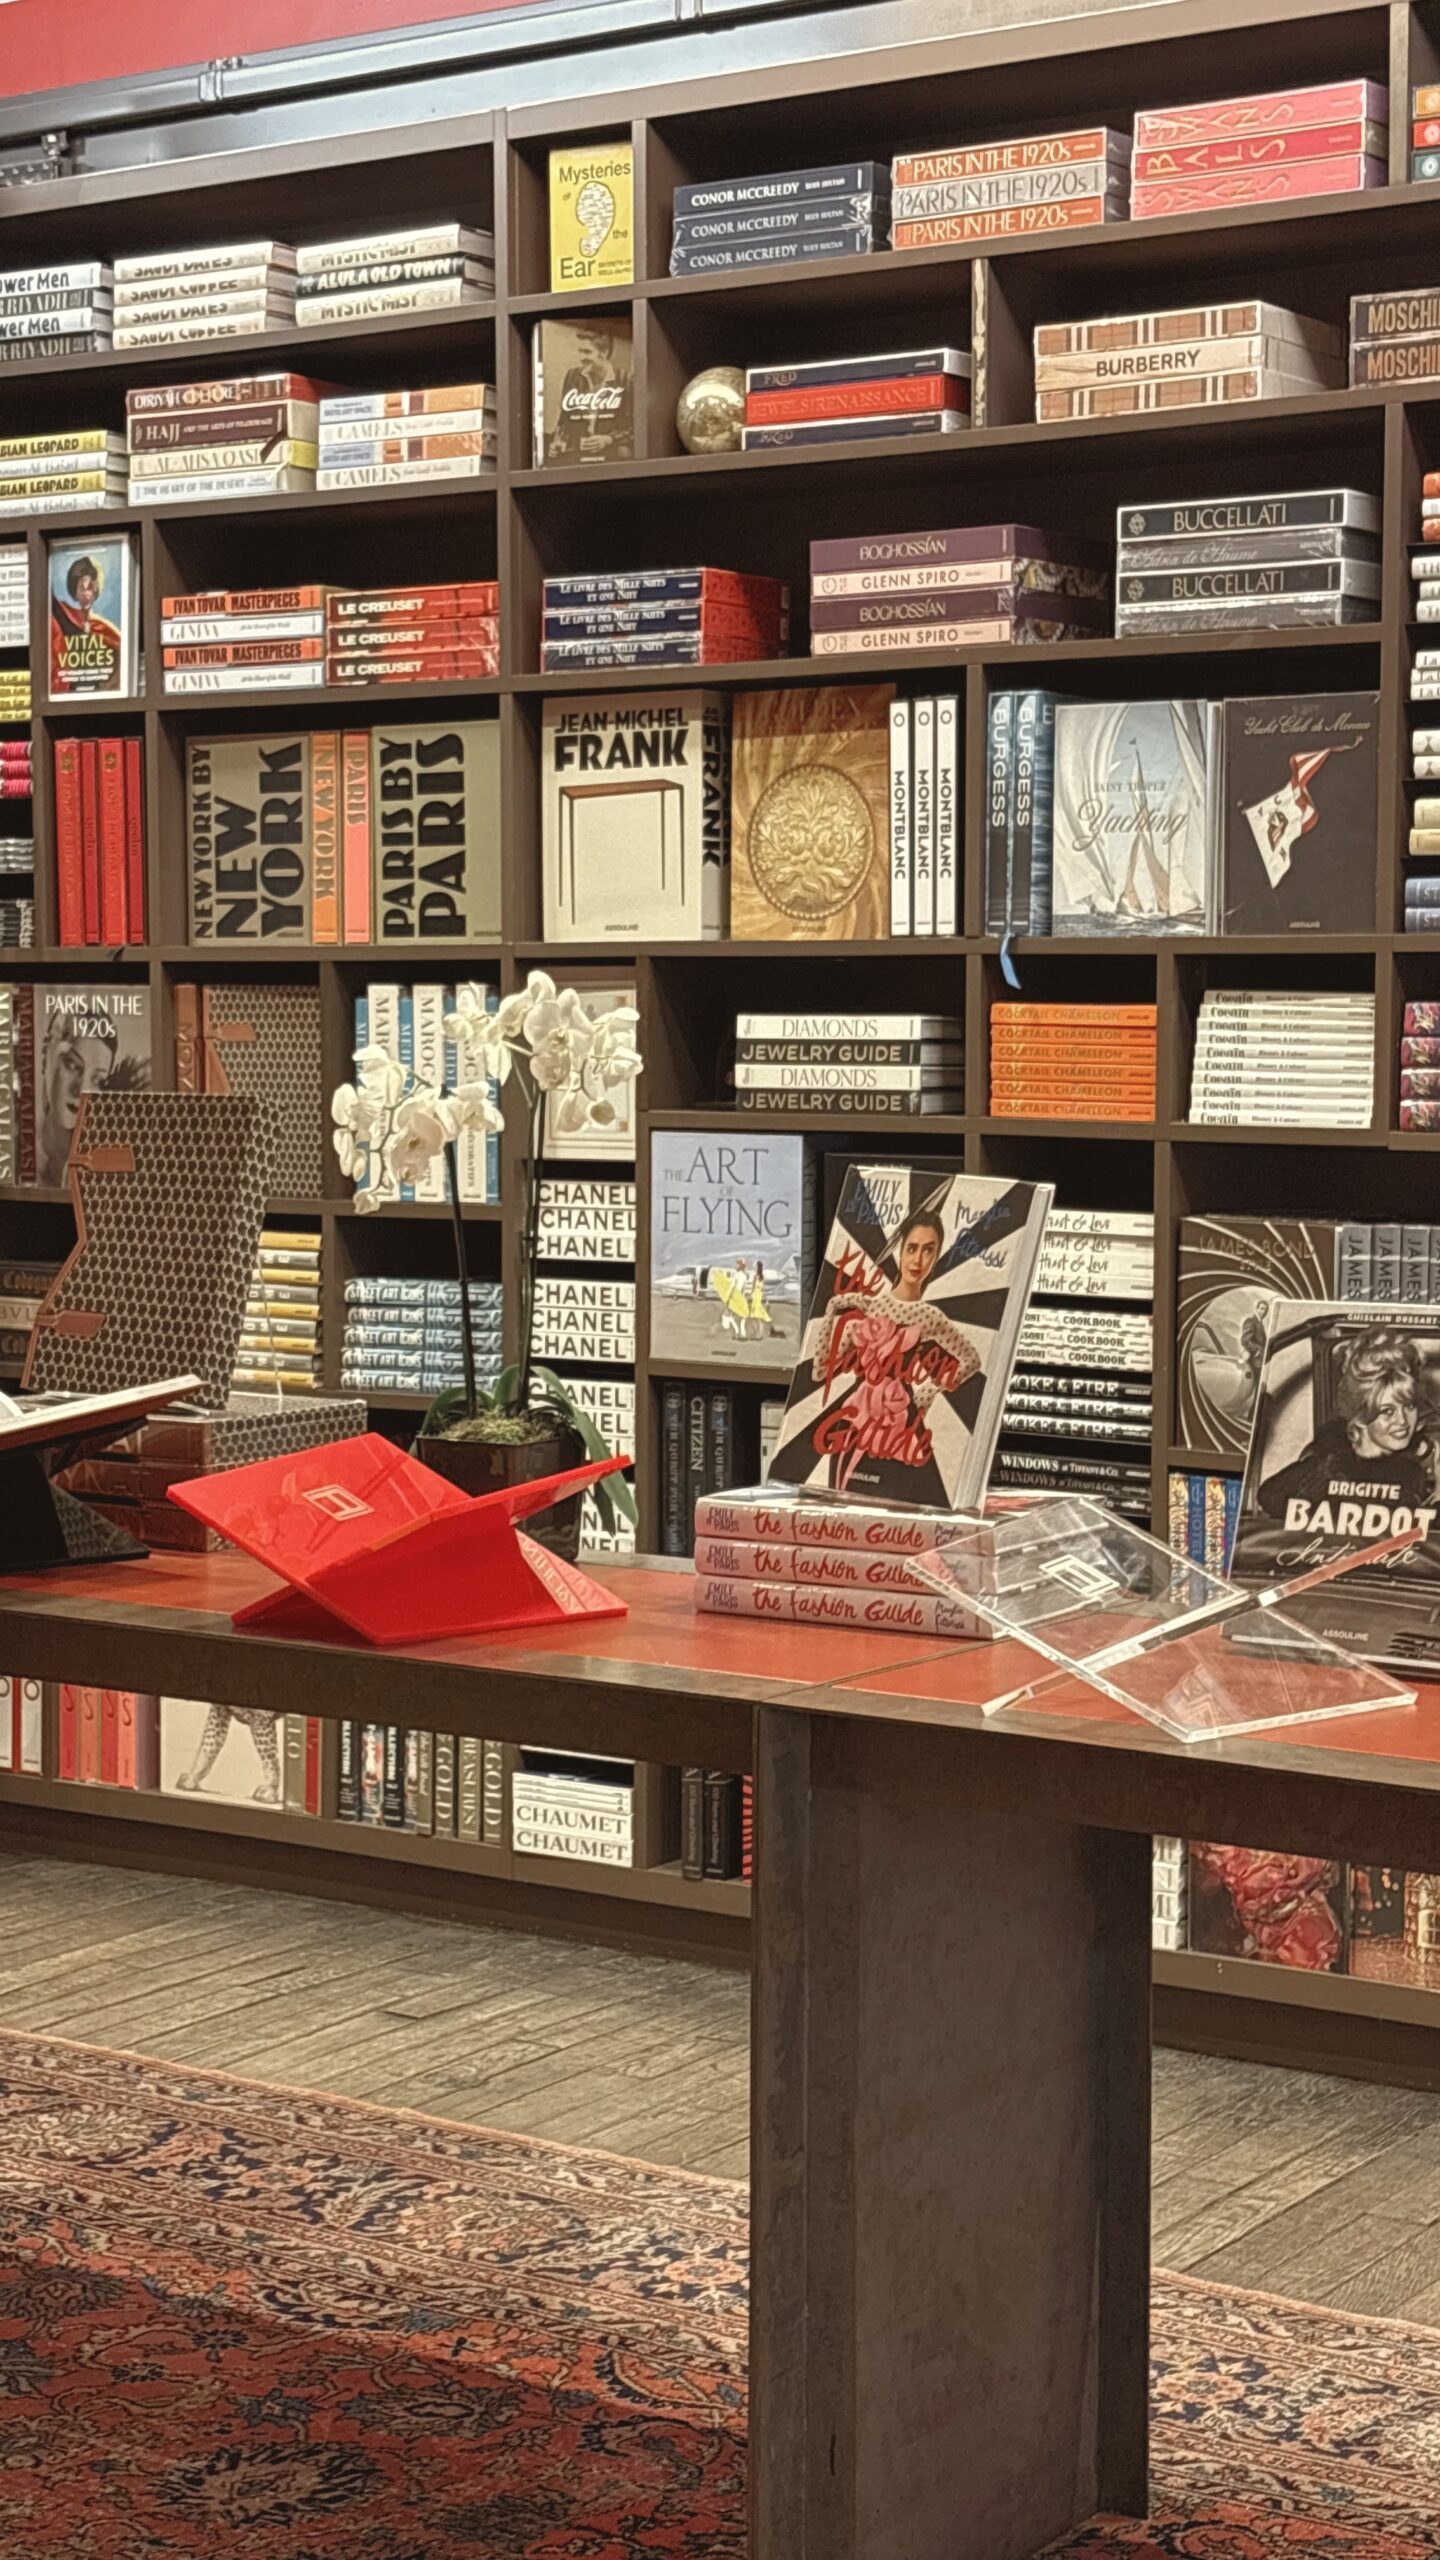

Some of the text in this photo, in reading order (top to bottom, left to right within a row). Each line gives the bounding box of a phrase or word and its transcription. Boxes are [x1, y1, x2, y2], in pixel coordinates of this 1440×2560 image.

[559, 161, 632, 186] Mysteries
[914, 141, 1071, 181] PARIS IN THE 1920s
[691, 189, 735, 208] CONOR
[737, 181, 800, 200] MCCREEDY
[900, 170, 1087, 216] PARIS IN THE 1920s
[612, 228, 629, 240] the
[691, 219, 735, 238] CONOR
[737, 213, 799, 232] MCCREEDY
[912, 205, 1068, 245] PARIS IN THE 1920s
[560, 257, 596, 280] Ear
[689, 250, 734, 268] CONOR
[735, 244, 797, 263] MCCREEDY
[37, 271, 70, 289] Men
[317, 258, 450, 291] ALULA OLD TOWN
[28, 316, 61, 334] Men
[1096, 349, 1200, 378] BURBERRY
[146, 423, 181, 443] HAJJ
[30, 438, 79, 455] LEOPARD
[336, 465, 402, 486] CAMELS
[1173, 503, 1287, 532] BUCCELLATI
[861, 569, 960, 591] GLENN SPIRO
[1172, 570, 1285, 599] BUCCELLATI
[174, 592, 301, 615] IVAN TOVAR MASTERPIECES
[338, 598, 425, 616] LE CREUSET
[64, 634, 108, 651] VITAL
[338, 630, 425, 647] LE CREUSET
[861, 628, 959, 649] GLENN SPIRO
[57, 650, 115, 668] VOICES
[337, 660, 424, 677] LE CREUSET
[555, 707, 689, 734] JEAN-MICHEL
[1243, 712, 1372, 736] Yacht Club de Monaco
[554, 728, 689, 773] FRANK
[992, 706, 1007, 828] BURGESS
[1017, 705, 1033, 826] BURGESS
[702, 725, 721, 868] FRANK
[416, 733, 467, 938] PARIS
[893, 770, 906, 880] MONTBLANC
[917, 769, 930, 879] MONTBLANC
[1072, 800, 1189, 852] Yachting
[192, 747, 213, 938] NEW YORK BY
[259, 742, 304, 938] YORK
[379, 737, 415, 938] PARIS BY
[214, 796, 258, 938] NEW
[45, 994, 144, 1015] PARIS IN THE
[72, 1016, 117, 1039] 1920s
[420, 996, 436, 1077] MAROC
[782, 1018, 879, 1039] DIAMONDS
[741, 1045, 902, 1063] JEWELRY GUIDE
[663, 1146, 769, 1186] THE ART
[539, 1184, 636, 1205] CHANEL
[719, 1186, 734, 1199] OF
[855, 1178, 902, 1204] EMILY
[541, 1209, 636, 1232] CHANEL
[662, 1195, 793, 1239] FLYING
[856, 1202, 904, 1228] PARIS
[533, 1236, 629, 1259] CHANEL
[833, 1239, 885, 1297] the
[1348, 1236, 1364, 1300] JAMES
[1378, 1236, 1394, 1301] JAMES
[533, 1283, 628, 1307] CHANEL
[532, 1309, 628, 1334] CHANEL
[530, 1334, 628, 1359] CHANEL
[822, 1307, 961, 1409] fashion
[1072, 1379, 1119, 1397] FIRE
[691, 1396, 705, 1472] CITIZEN
[811, 1405, 933, 1467] Guide
[1001, 1454, 1059, 1471] WINDOWS
[1000, 1470, 1056, 1487] WINDOWS
[1328, 1480, 1401, 1500] BRIGITTE
[753, 1510, 925, 1549] the fashion Guide
[1283, 1498, 1437, 1542] BARDOT
[753, 1548, 783, 1574] the
[790, 1548, 859, 1581] fashion
[752, 1587, 925, 1627] the fashion Guide
[1322, 1628, 1369, 1641] ASSOULINE
[485, 1753, 502, 1825] GOLD
[516, 1804, 628, 1835] CHAUMET
[516, 1831, 629, 1862] CHAUMET
